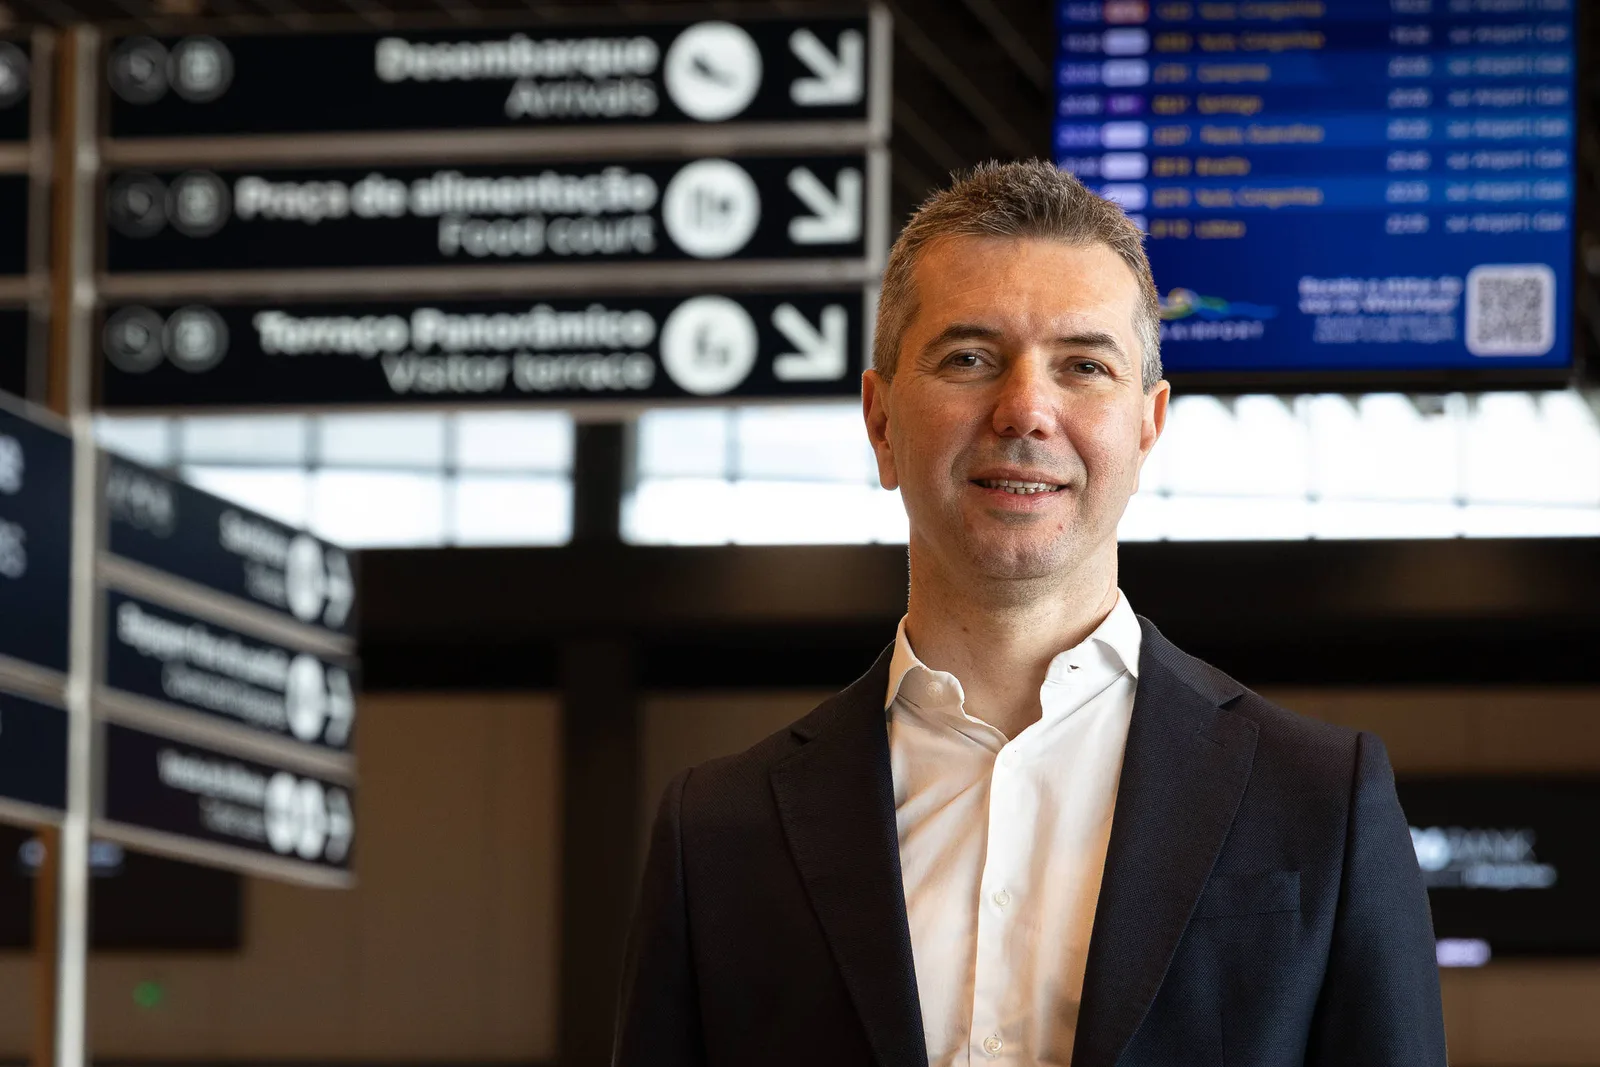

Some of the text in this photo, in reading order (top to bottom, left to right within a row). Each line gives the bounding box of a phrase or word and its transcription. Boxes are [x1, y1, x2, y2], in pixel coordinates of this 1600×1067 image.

[375, 33, 659, 82] Desembarque
[505, 78, 659, 118] Arrivals
[234, 166, 657, 223] Praça de alimentação
[438, 212, 656, 257] Food court
[254, 303, 656, 358] Terraço Panorâmico
[382, 349, 656, 393] Visitor terrace
